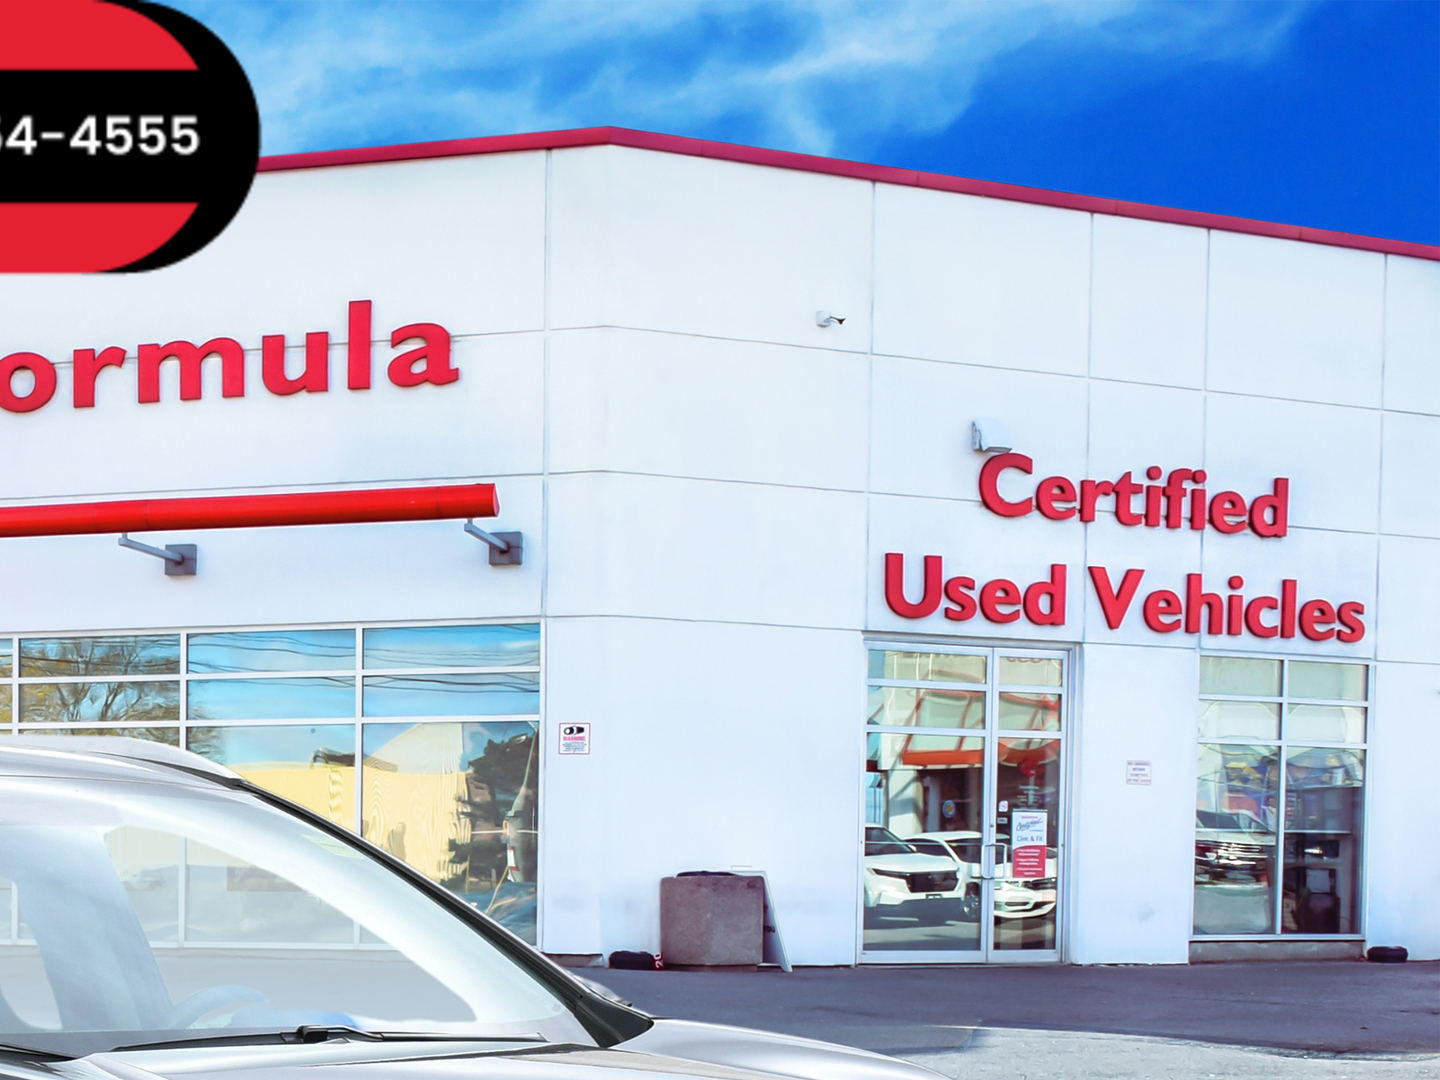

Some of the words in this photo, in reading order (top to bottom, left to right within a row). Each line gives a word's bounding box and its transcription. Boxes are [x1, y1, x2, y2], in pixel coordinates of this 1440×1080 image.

[978, 452, 1290, 538] Certified
[885, 552, 1068, 627] Used
[1088, 565, 1366, 644] Vehicles
